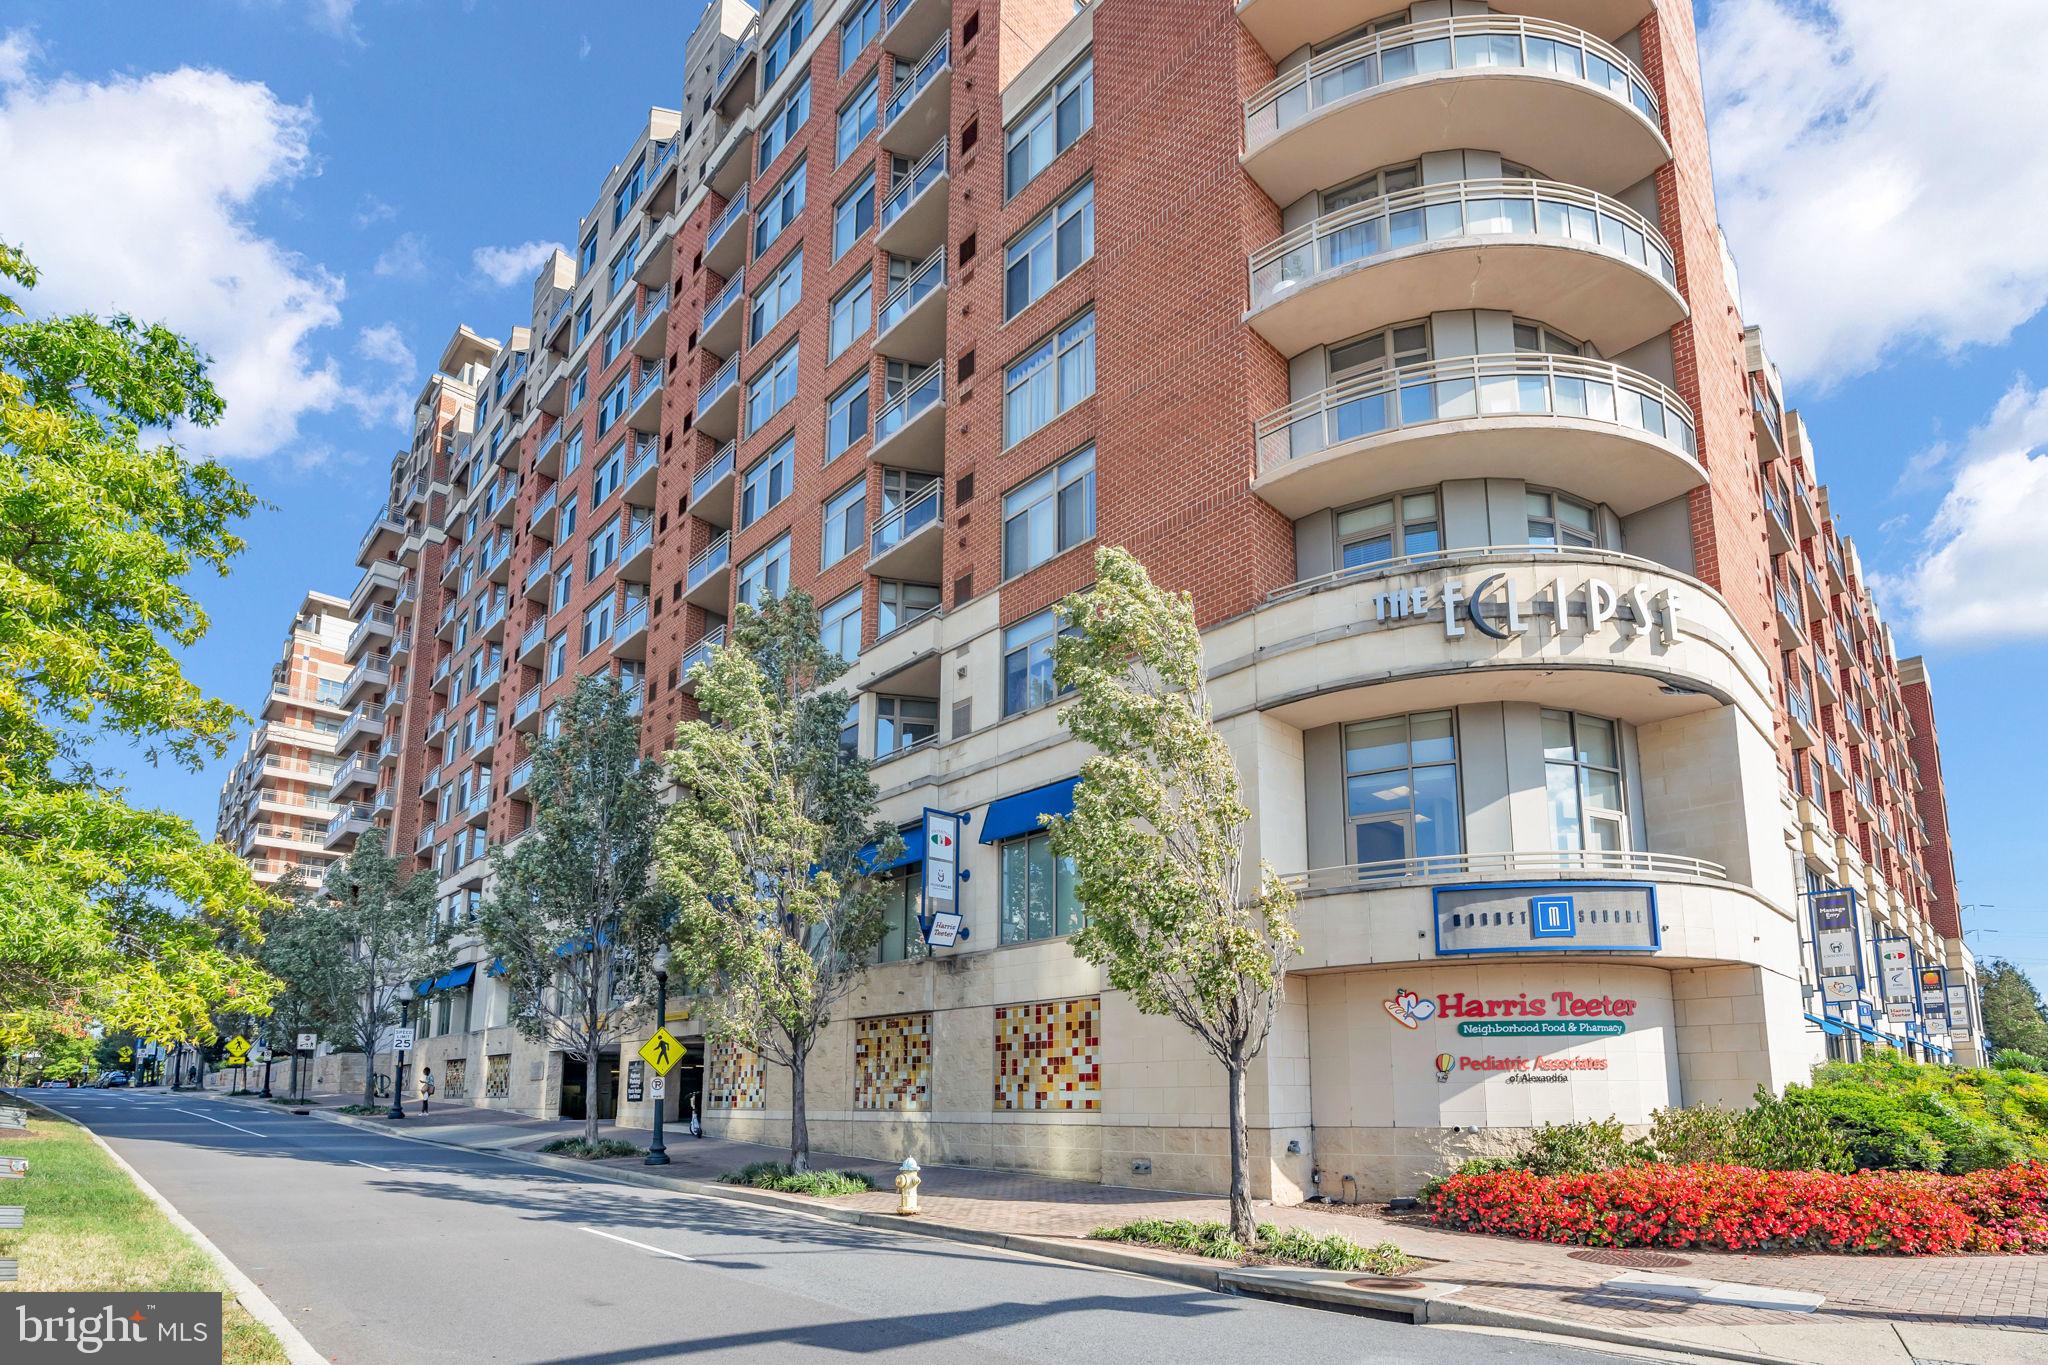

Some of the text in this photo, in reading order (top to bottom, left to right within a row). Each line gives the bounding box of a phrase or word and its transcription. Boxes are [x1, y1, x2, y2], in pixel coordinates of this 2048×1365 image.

[1373, 572, 1683, 645] THE ECLIPSE
[1436, 991, 1637, 1019] Harris Teeter
[1463, 1022, 1623, 1036] Neighborhood Food & Pharmacy
[395, 1039, 411, 1048] 25
[1459, 1055, 1608, 1072] Pediatric Associates
[1509, 1073, 1569, 1083] of Alexandria
